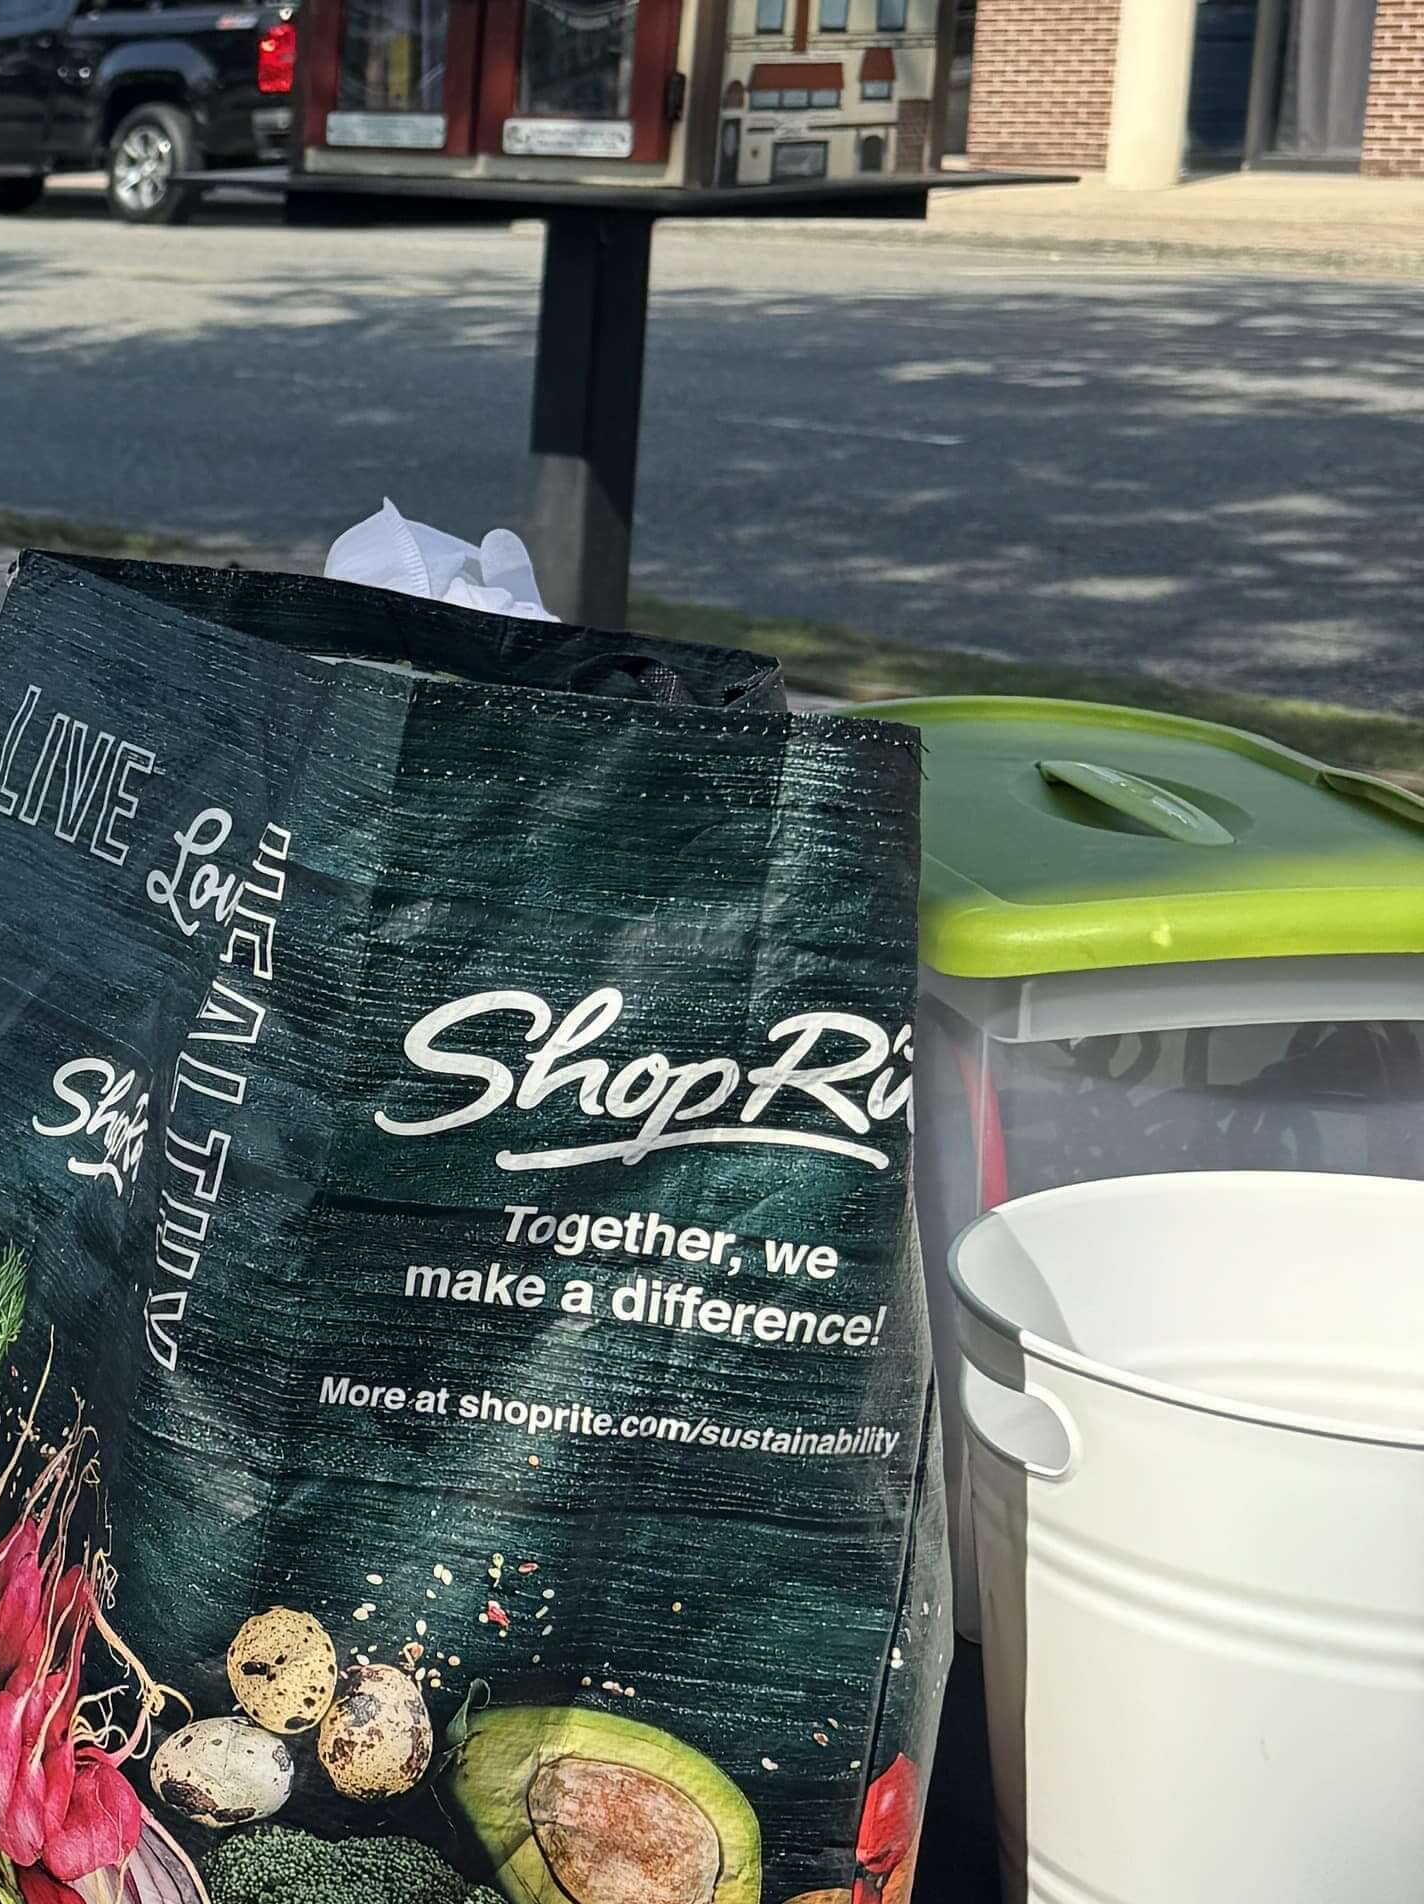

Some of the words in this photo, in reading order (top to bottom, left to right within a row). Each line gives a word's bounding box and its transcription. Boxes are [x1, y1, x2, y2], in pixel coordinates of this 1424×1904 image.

[146, 807, 246, 936] Lov
[374, 987, 915, 1170] ShopRi
[503, 1205, 742, 1277] Together,
[764, 1240, 839, 1280] we
[404, 1263, 547, 1309] make
[561, 1280, 593, 1314] a
[610, 1273, 887, 1347] difference!
[319, 1376, 407, 1412] More
[414, 1384, 450, 1415] at
[457, 1391, 901, 1457] shoprite.com/sustainability
